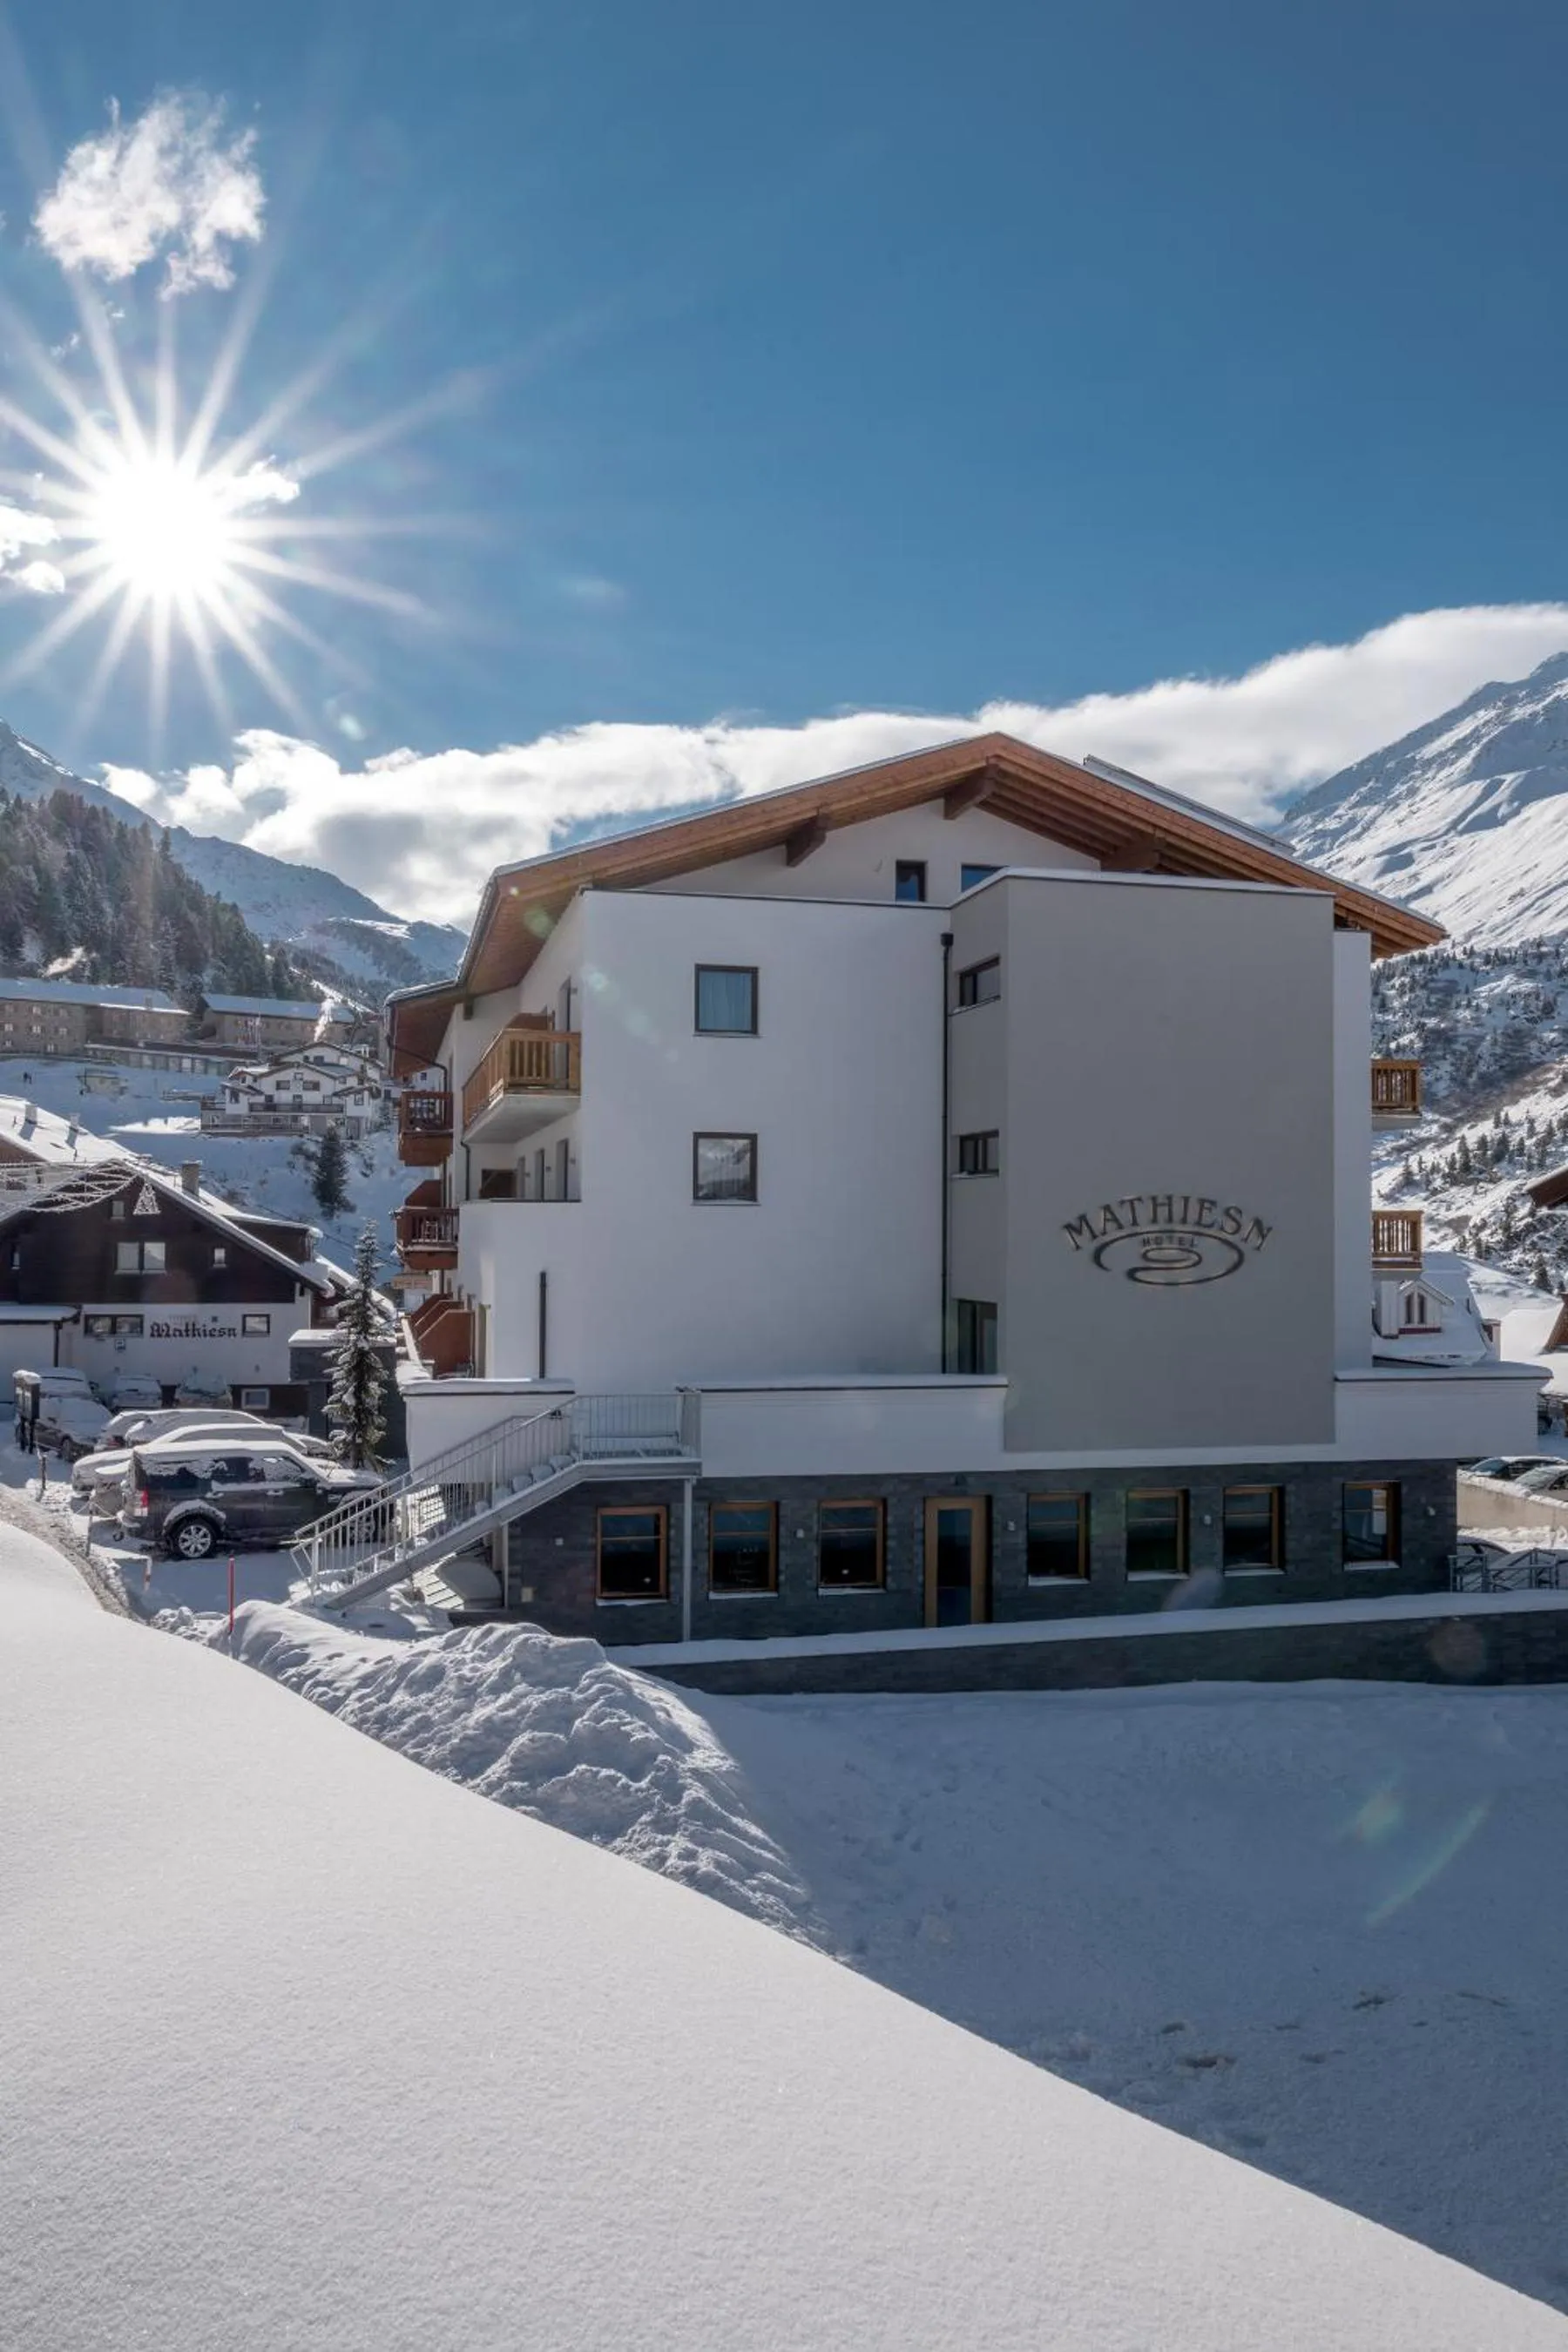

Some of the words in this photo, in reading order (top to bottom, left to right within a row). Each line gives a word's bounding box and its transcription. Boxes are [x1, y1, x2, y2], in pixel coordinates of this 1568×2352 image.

[1062, 1194, 1273, 1252] MATHIESN
[1142, 1235, 1198, 1247] HOTEL
[150, 1321, 237, 1338] Mathiesn
